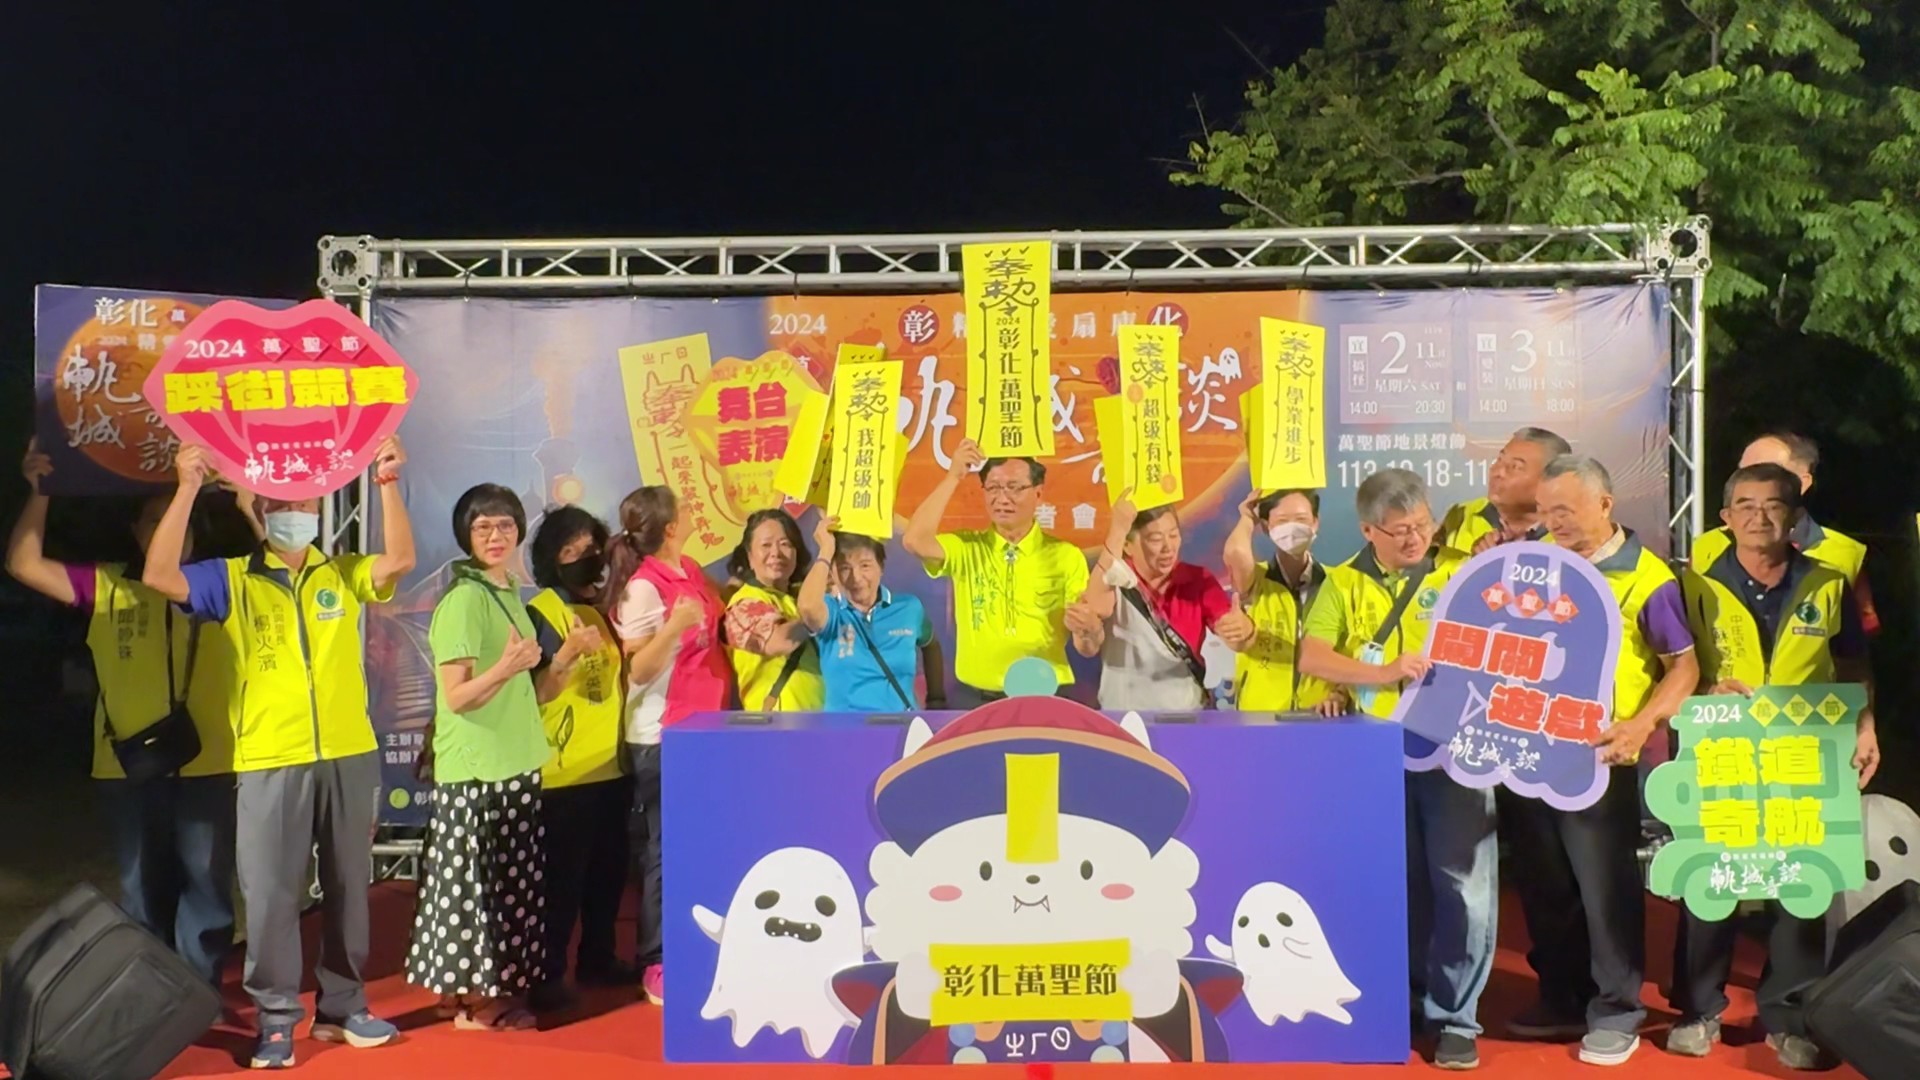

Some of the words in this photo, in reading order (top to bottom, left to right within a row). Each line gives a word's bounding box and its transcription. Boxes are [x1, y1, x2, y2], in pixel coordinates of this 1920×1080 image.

[94, 296, 160, 328] 彰化
[769, 314, 828, 336] 2024
[996, 316, 1021, 326] 2024
[184, 339, 247, 359] 2024
[261, 337, 360, 354] 萬聖節
[1380, 331, 1409, 374] 2
[1510, 329, 1537, 373] 3
[163, 365, 409, 415] 踩街競賽
[717, 380, 788, 424] 舞台
[998, 326, 1023, 449] 彰化萬聖節
[1415, 400, 1446, 414] 20:30
[718, 424, 789, 468] 表演
[1142, 398, 1162, 485] 超級有錢
[1284, 385, 1304, 465] 學業進步
[1338, 433, 1468, 451] 萬聖節地景燈飾
[853, 427, 876, 511] 我超級帥
[1508, 563, 1562, 587] 2024
[1691, 703, 1743, 724] 2024
[1754, 699, 1842, 719] 萬聖節
[1693, 734, 1823, 789] 鐵道
[1698, 796, 1826, 848] 奇航
[943, 962, 1119, 998] 彰化萬聖節
